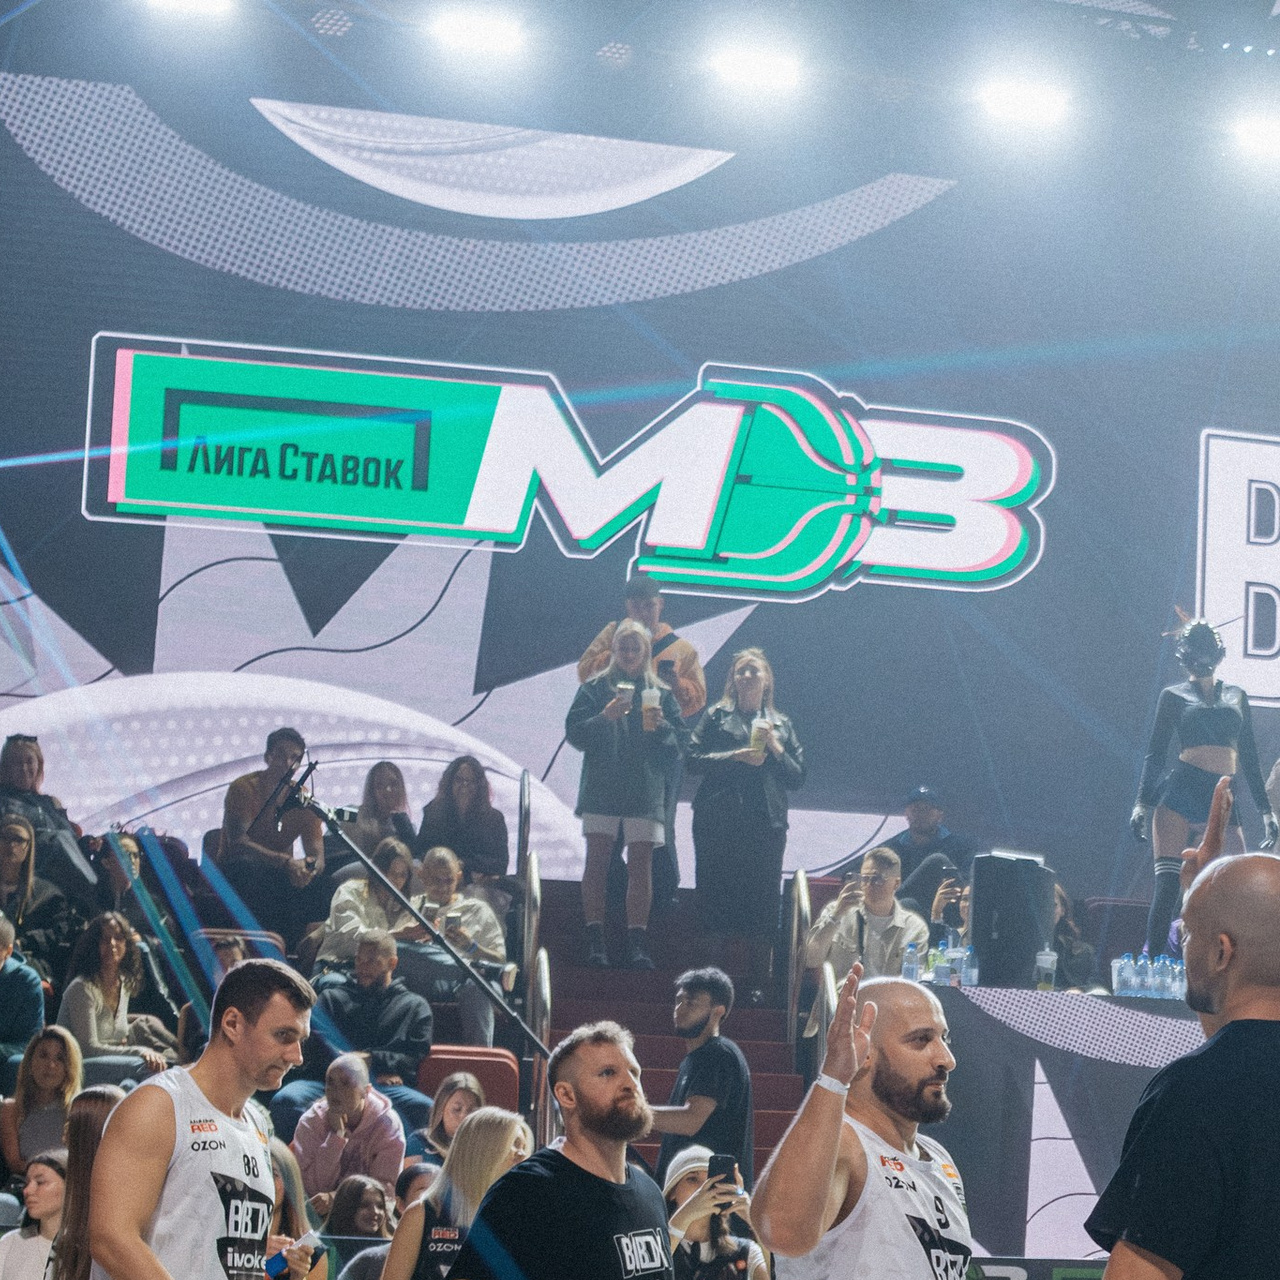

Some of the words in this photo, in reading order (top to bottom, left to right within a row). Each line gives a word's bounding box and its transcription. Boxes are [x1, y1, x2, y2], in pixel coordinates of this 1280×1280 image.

[279, 443, 405, 492] СТАВОК
[190, 1123, 218, 1133] RED
[191, 1140, 226, 1151] OZON
[243, 1154, 260, 1179] 88
[933, 1196, 950, 1229] 9
[429, 1242, 462, 1251] OZON
